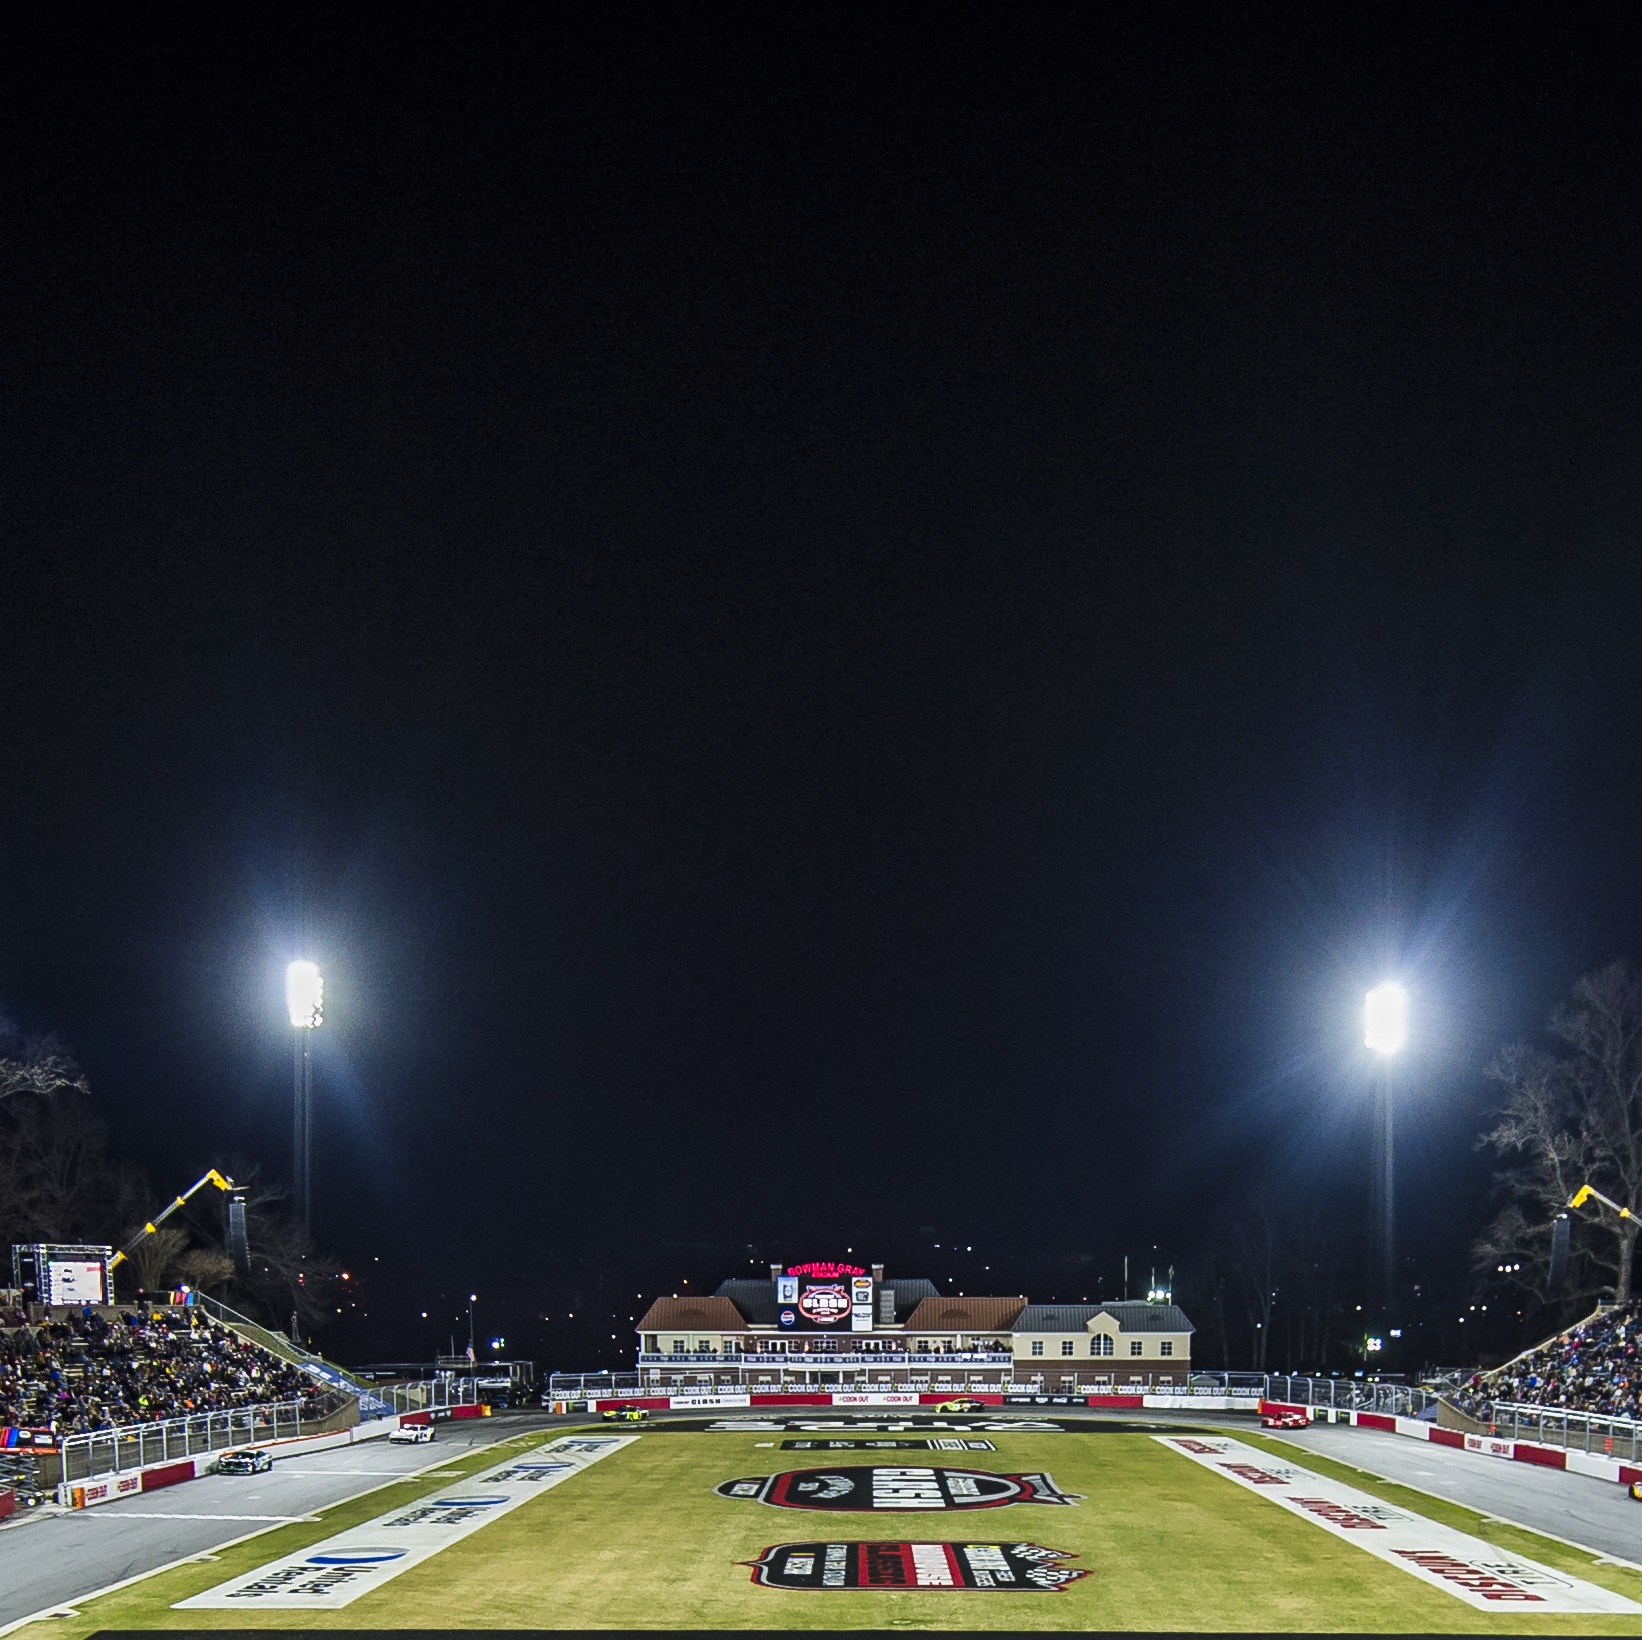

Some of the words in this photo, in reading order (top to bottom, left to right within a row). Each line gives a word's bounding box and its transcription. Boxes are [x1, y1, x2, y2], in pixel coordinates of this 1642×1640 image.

[787, 1261, 835, 1277] BOWMAN
[837, 1263, 866, 1276] GRAY
[872, 1468, 946, 1508] CLASH
[225, 1565, 326, 1599] Rentals
[288, 1565, 379, 1594] United
[1390, 1549, 1547, 1602] DISCOUNT
[1481, 1560, 1560, 1586] TIRE
